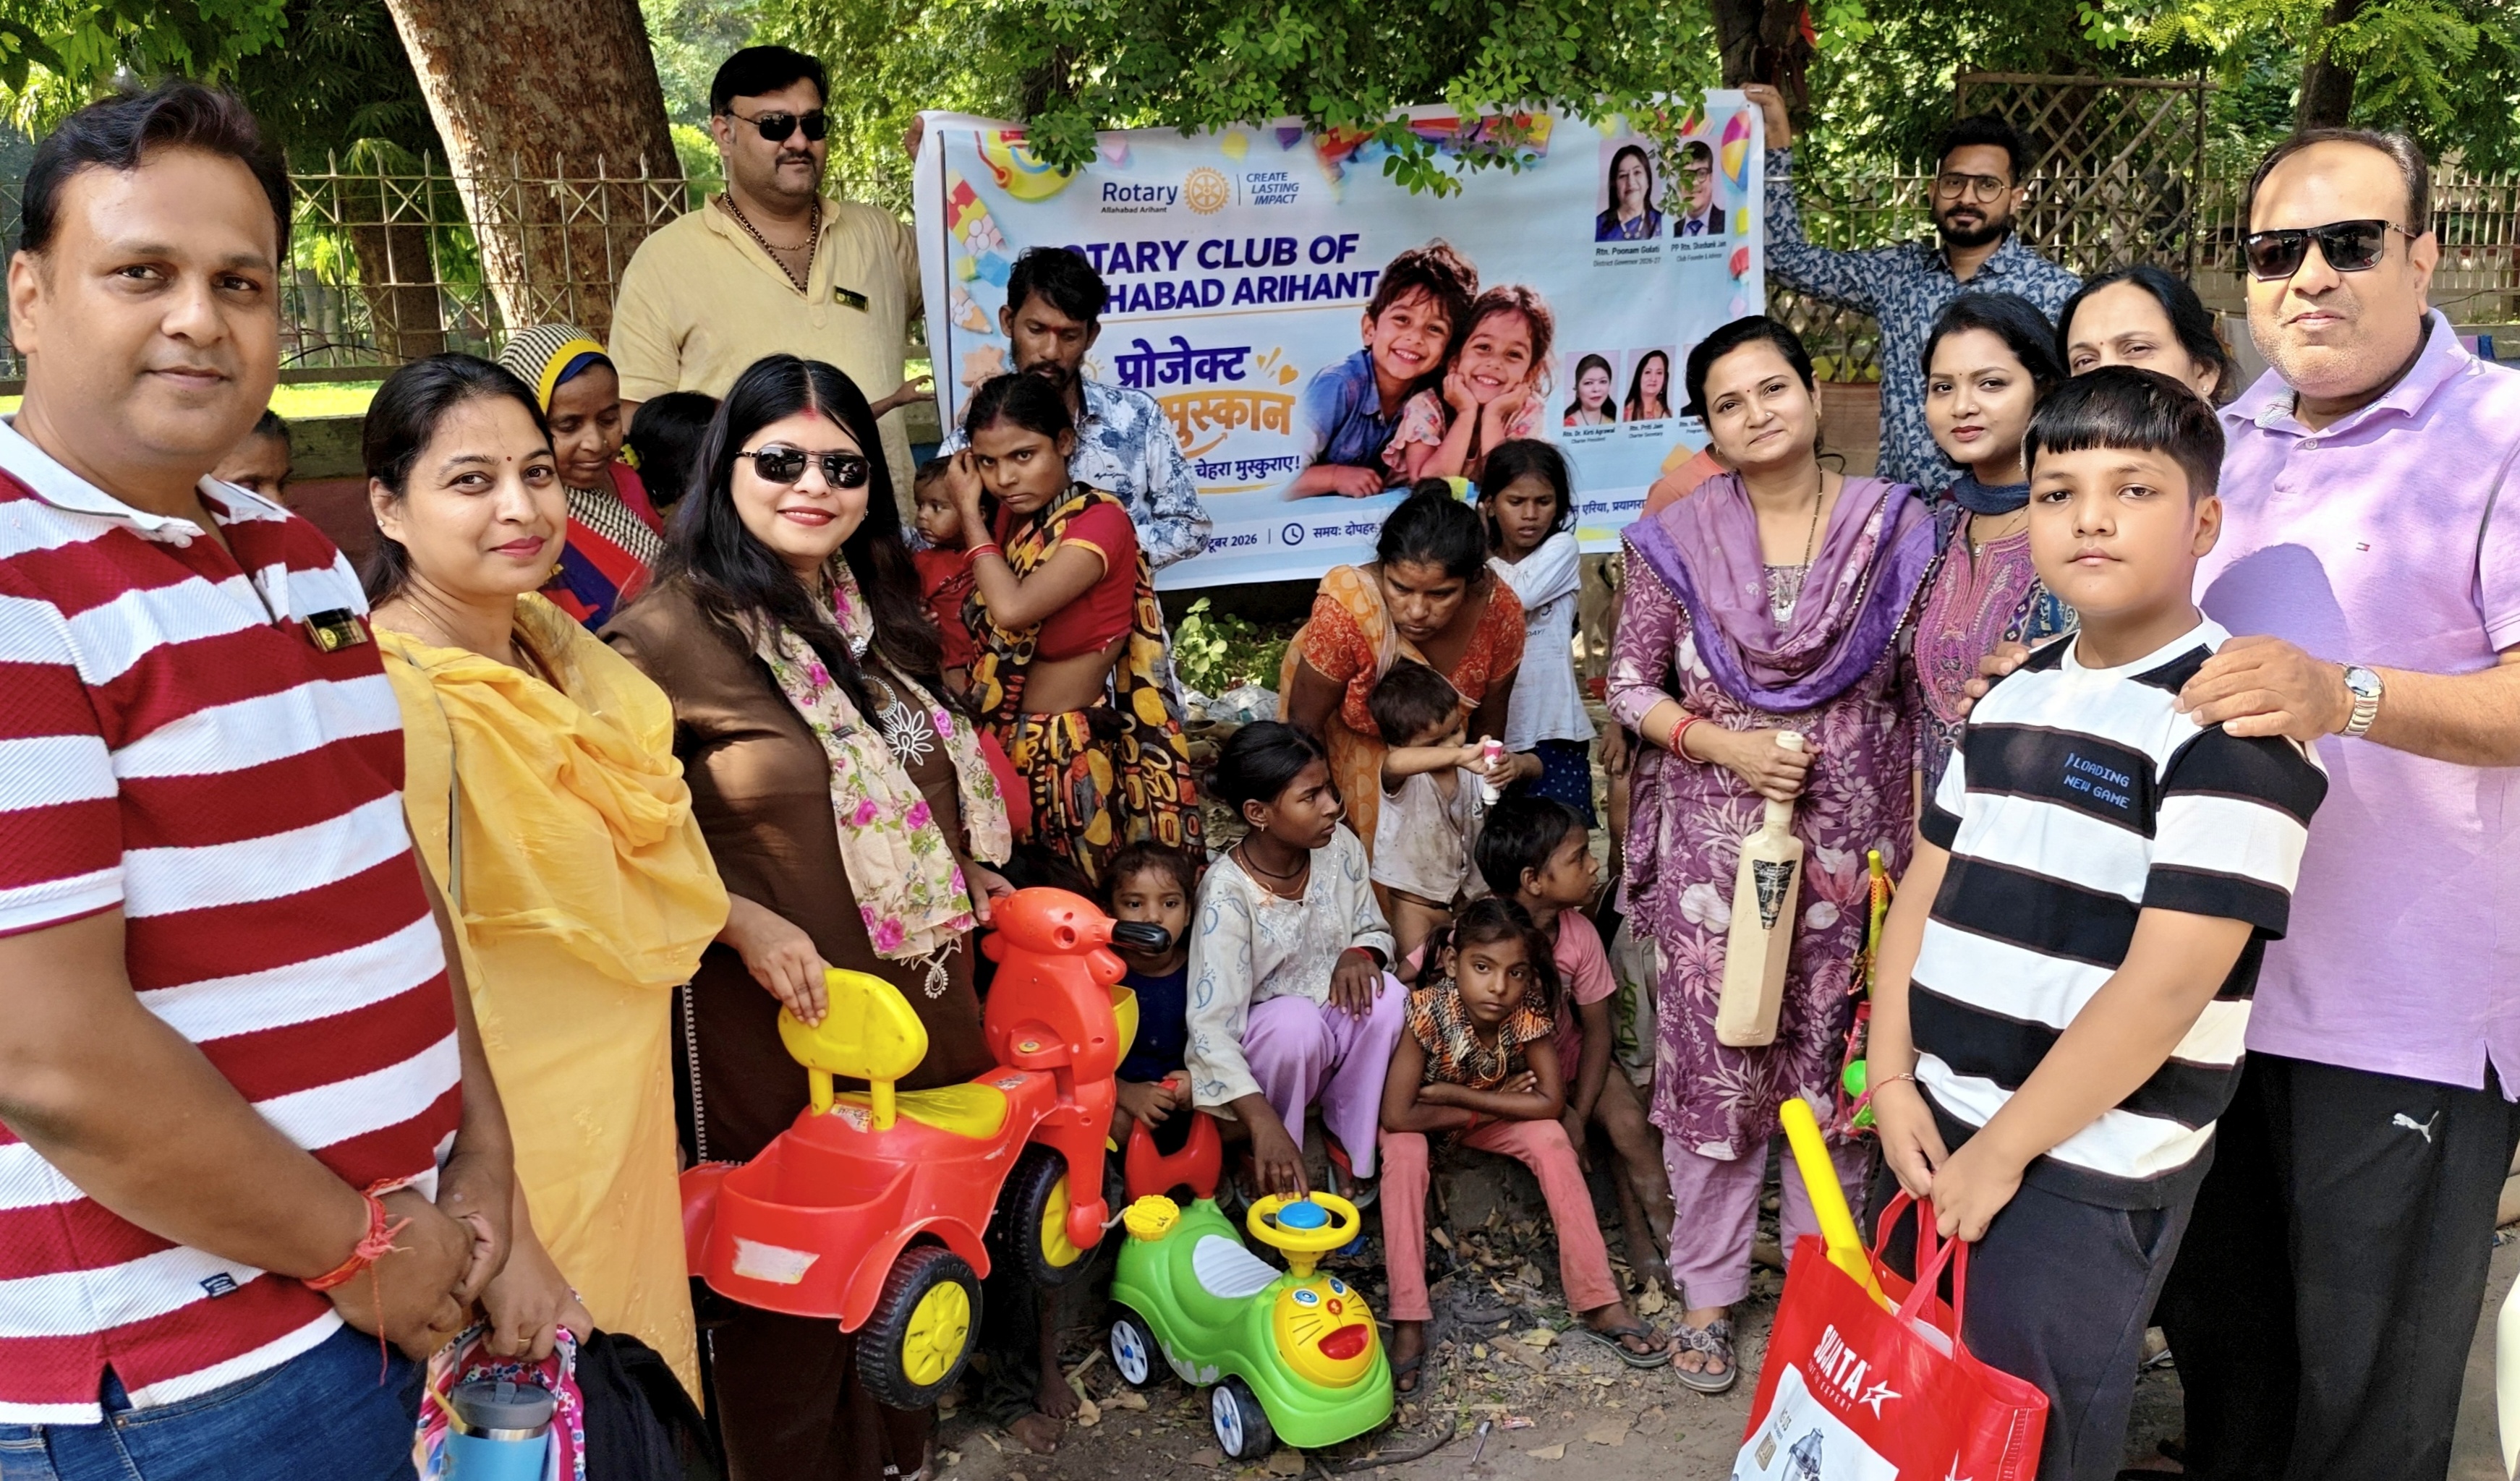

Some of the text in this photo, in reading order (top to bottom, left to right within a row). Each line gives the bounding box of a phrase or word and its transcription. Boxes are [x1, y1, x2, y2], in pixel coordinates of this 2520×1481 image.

[1246, 172, 1288, 182] CREATE
[1251, 182, 1299, 194] LASTING
[1102, 182, 1178, 205] Rotary
[1254, 194, 1297, 205] IMPACT
[1062, 234, 1360, 276] TARY CLUB OF
[1640, 245, 1660, 254] Gulati
[1098, 270, 1380, 315] HABAD ARIHANT
[1115, 336, 1251, 388] प्रोजेक्ट
[1158, 390, 1296, 448] मुस्कान
[1194, 456, 1300, 480] चेहरा मुस्कुराए!
[1582, 500, 1609, 515] एरिया,
[1612, 499, 1648, 511] प्रयागरा
[1208, 537, 1229, 553] टूबर
[1231, 534, 1258, 547] 2026
[2073, 757, 2130, 788] LOADING
[2064, 774, 2131, 809] NEW GAME
[1813, 1324, 1868, 1400] SUJATA
[1820, 1381, 1852, 1412] EXPERT
